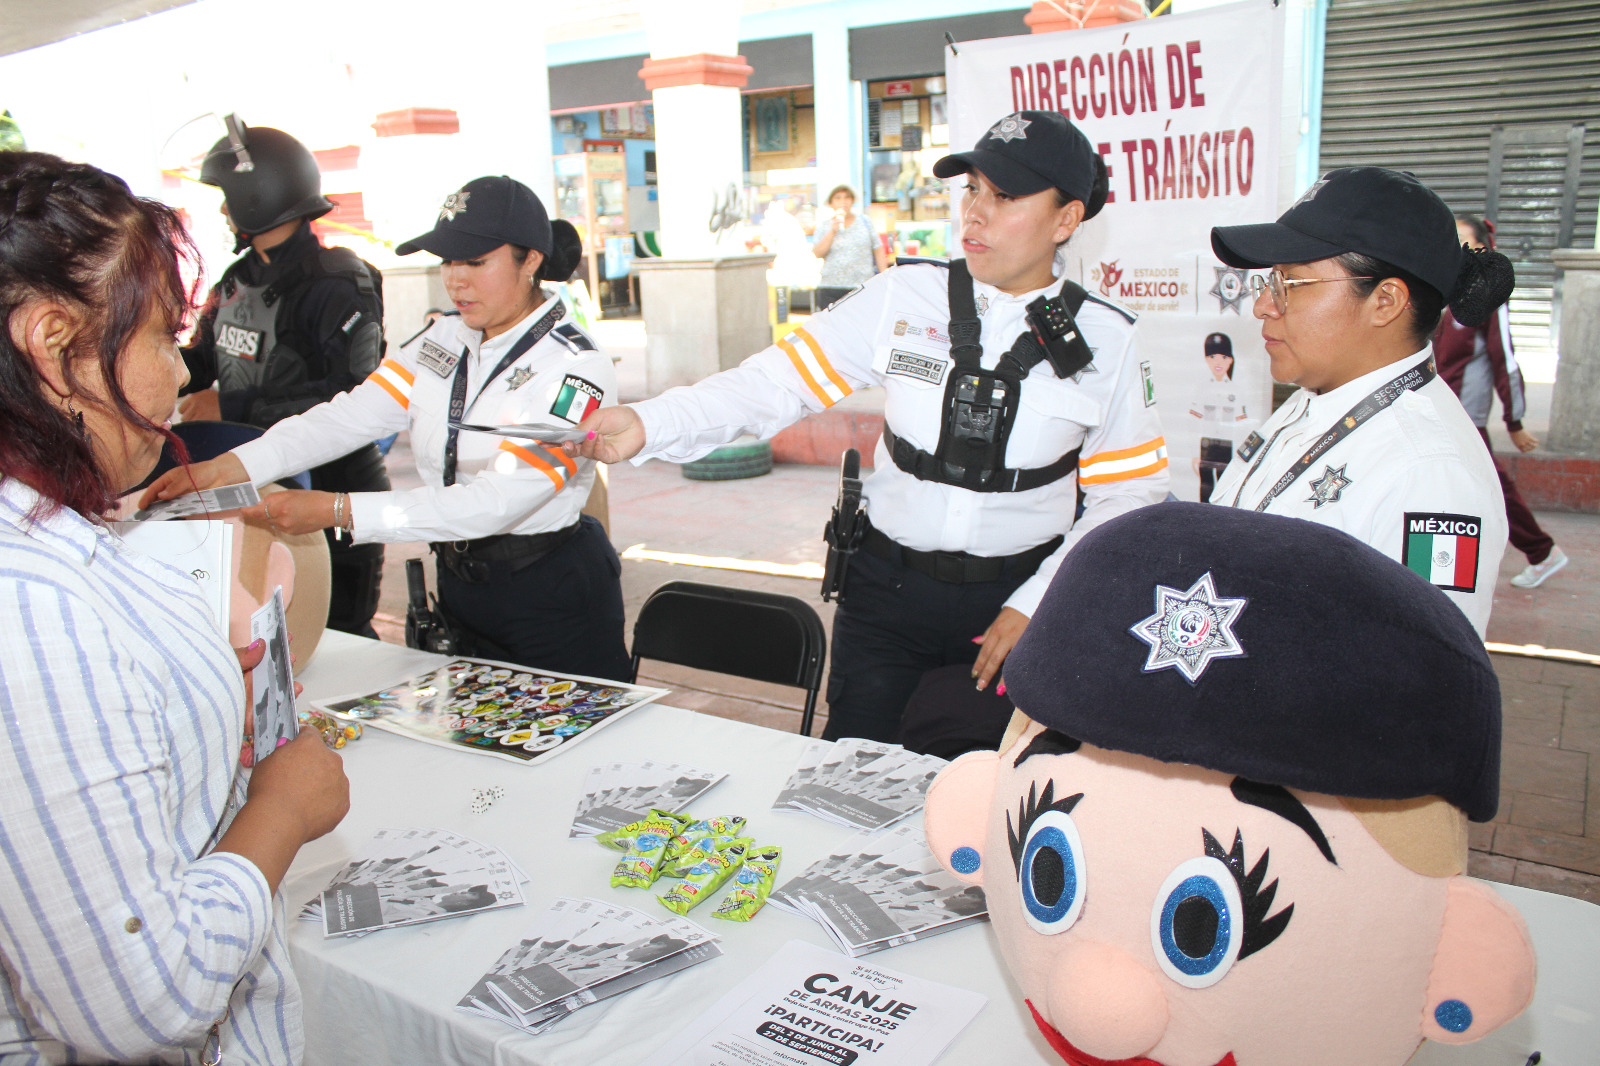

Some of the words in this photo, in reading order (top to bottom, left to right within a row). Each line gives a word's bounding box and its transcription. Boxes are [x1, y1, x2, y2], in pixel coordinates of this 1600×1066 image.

[1010, 32, 1157, 121] DIRECCIÓN
[1165, 40, 1205, 110] DE
[1121, 119, 1254, 202] TRÁNSITO
[1134, 268, 1167, 278] ESTADO
[1168, 268, 1179, 277] DE
[1120, 280, 1178, 297] MÉXICO
[550, 304, 564, 320] SS
[216, 324, 260, 354] ASES
[565, 376, 602, 402] MÉXICO
[1378, 396, 1389, 406] DE
[450, 400, 463, 417] SS
[1410, 518, 1478, 536] MÉXICO
[789, 989, 811, 1002] DE
[810, 998, 862, 1019] ARMAS
[860, 1014, 899, 1030] 2025
[804, 973, 917, 1020] CANJE
[764, 1004, 884, 1053] ¡PARTICIPA!
[832, 1016, 868, 1029] construye
[768, 1024, 786, 1034] DEL
[794, 1034, 809, 1042] DE
[807, 1039, 835, 1051] JUNIO
[835, 1048, 848, 1057] AL
[774, 1035, 790, 1044] DE
[789, 1041, 844, 1064] SEPTIEMBRE
